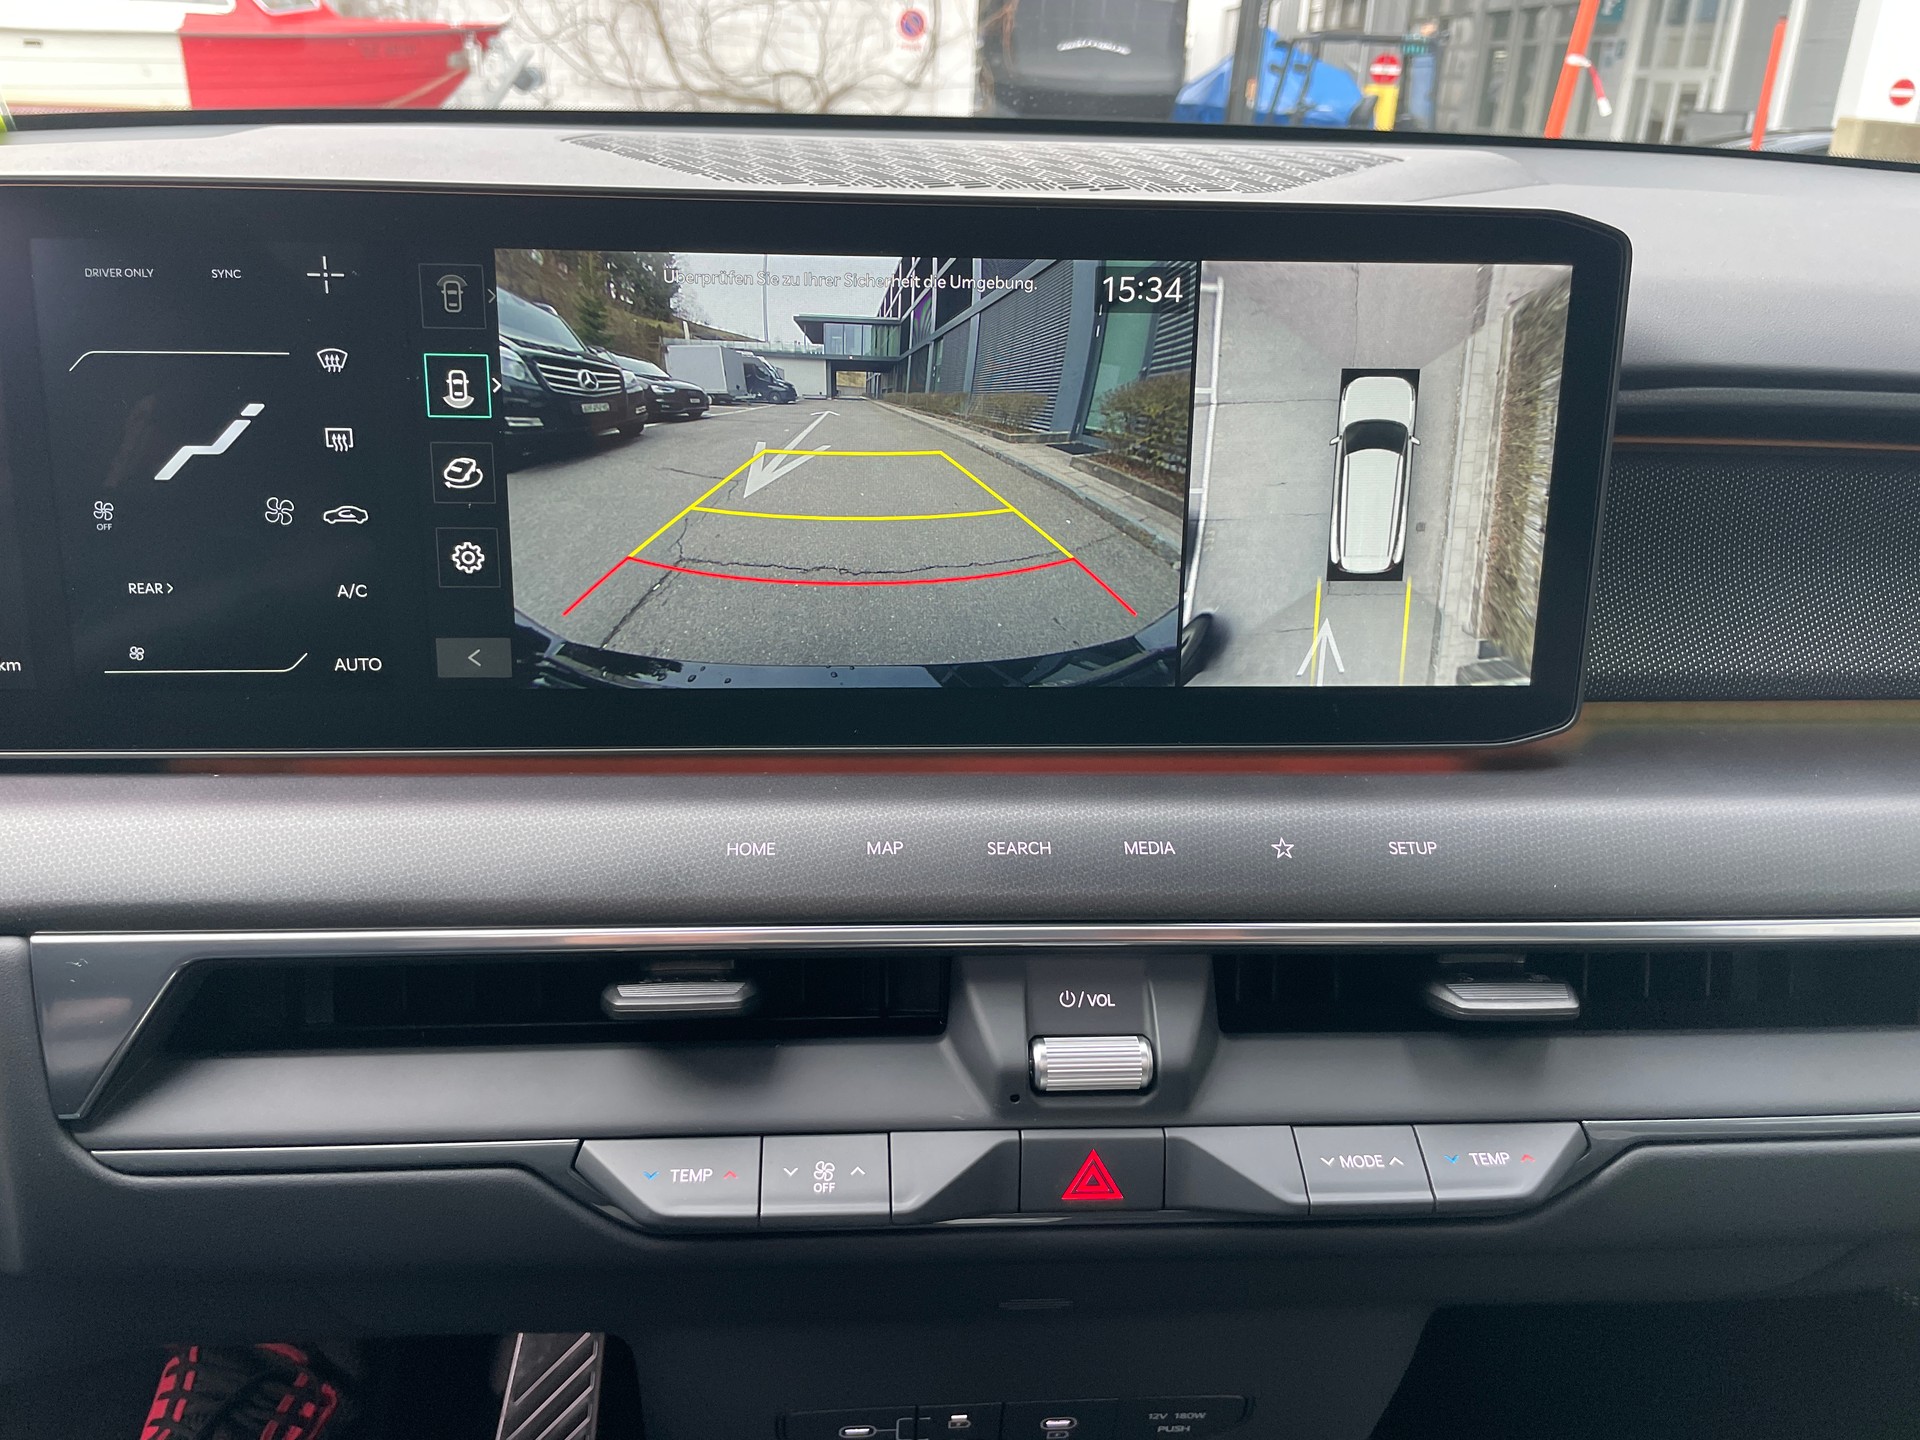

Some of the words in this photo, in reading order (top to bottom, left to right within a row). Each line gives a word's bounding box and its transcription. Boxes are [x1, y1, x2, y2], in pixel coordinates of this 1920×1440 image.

[84, 268, 122, 278] DRIVER
[124, 268, 154, 279] ONLY
[210, 268, 242, 280] SYNC
[663, 263, 754, 288] Überprüfen
[756, 270, 780, 286] Sie
[782, 274, 800, 287] zu
[803, 272, 841, 287] Ihrer
[843, 272, 920, 289] Sicherheit
[923, 276, 946, 289] die
[949, 275, 1038, 293] Umgebung.
[1102, 276, 1184, 304] 15:34
[96, 522, 113, 531] OFF
[128, 582, 163, 595] REAR
[337, 583, 368, 599] A/C
[334, 657, 382, 673] AUTO
[726, 841, 776, 857] HOME
[866, 841, 904, 856] MAP
[987, 841, 1052, 857] SEARCH
[1123, 841, 1176, 856] MEDIA
[1388, 841, 1438, 857] SETUP
[1339, 1154, 1385, 1169] MODE
[1468, 1151, 1510, 1166] TEMP
[670, 1168, 713, 1183] TEMP
[813, 1182, 836, 1194] OFF
[1148, 1412, 1169, 1420] 12V
[1174, 1412, 1207, 1420] 180W
[1157, 1425, 1191, 1433] PUSH
